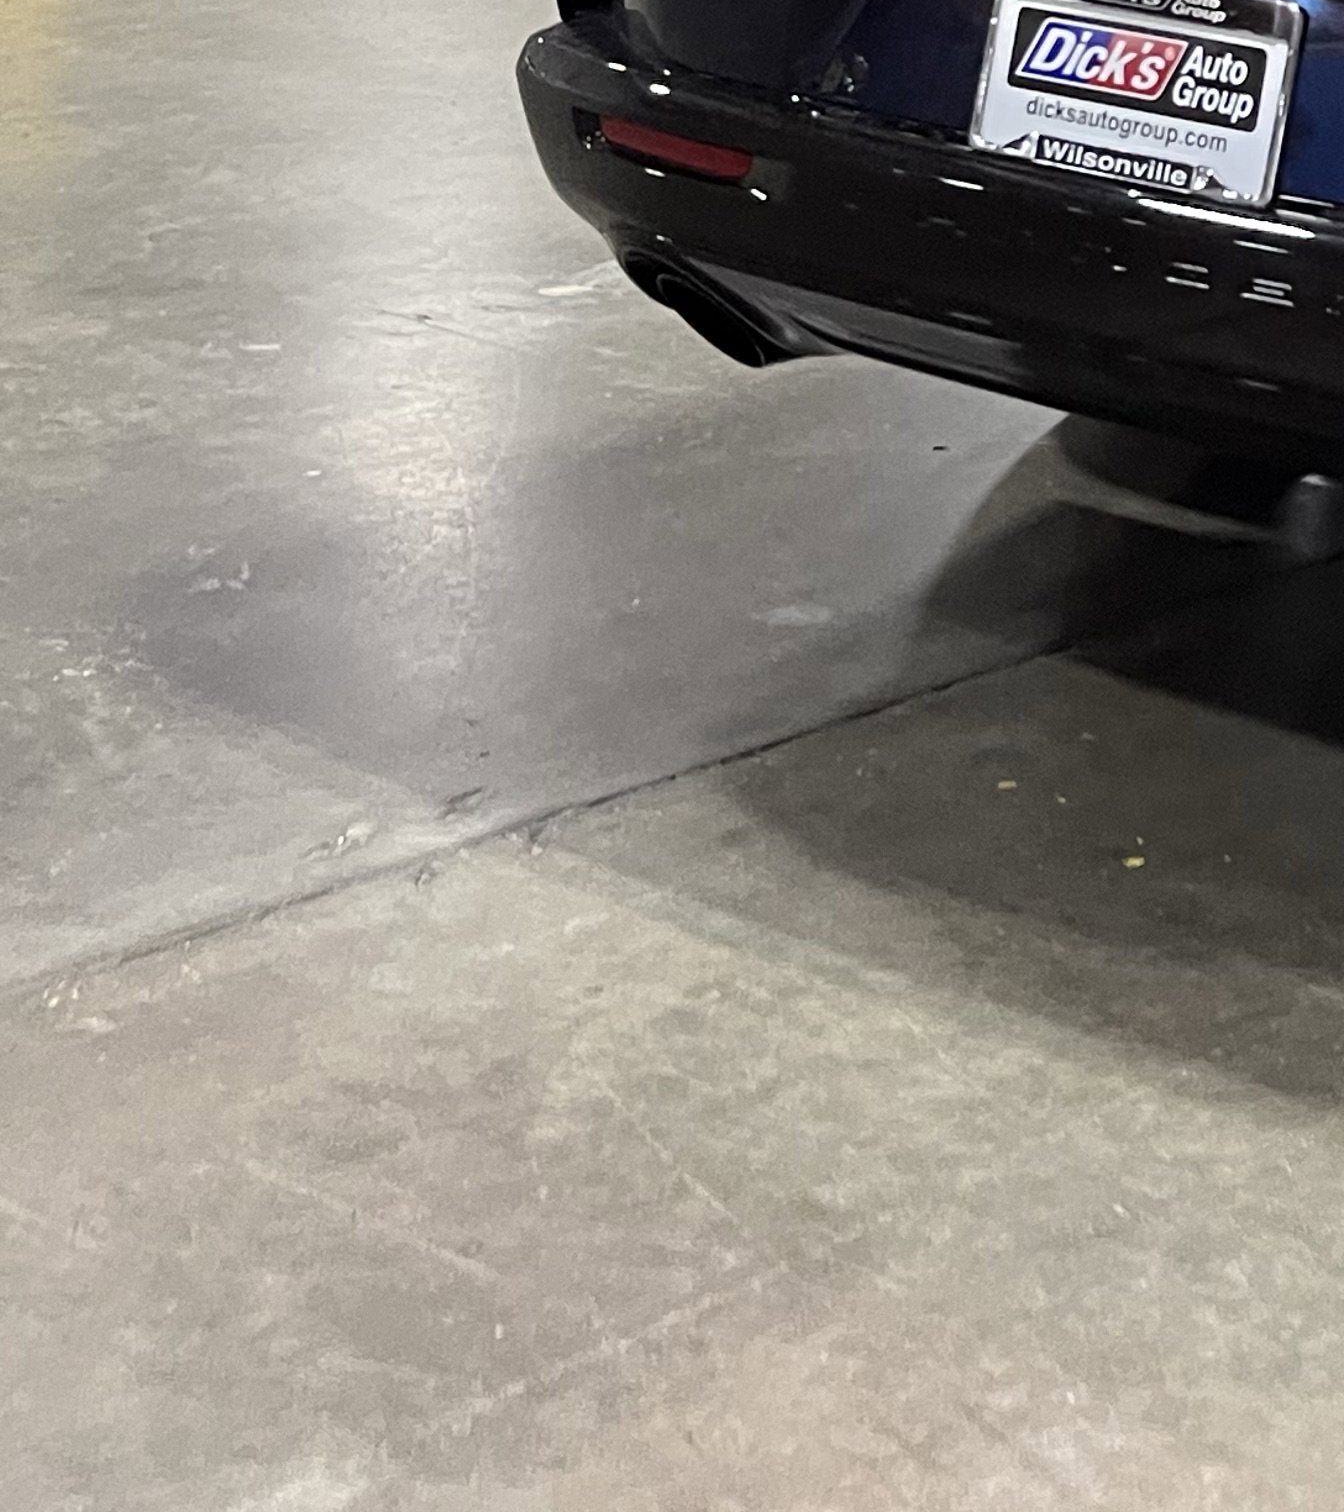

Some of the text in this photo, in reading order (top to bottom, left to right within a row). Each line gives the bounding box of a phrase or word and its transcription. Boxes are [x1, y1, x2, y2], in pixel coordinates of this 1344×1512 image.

[1171, 2, 1227, 23] Group
[1029, 27, 1248, 90] Dick's Auto
[1026, 96, 1228, 152] dicksautogroup.com
[1172, 76, 1254, 124] Group
[1042, 139, 1188, 186] Wilsonville
